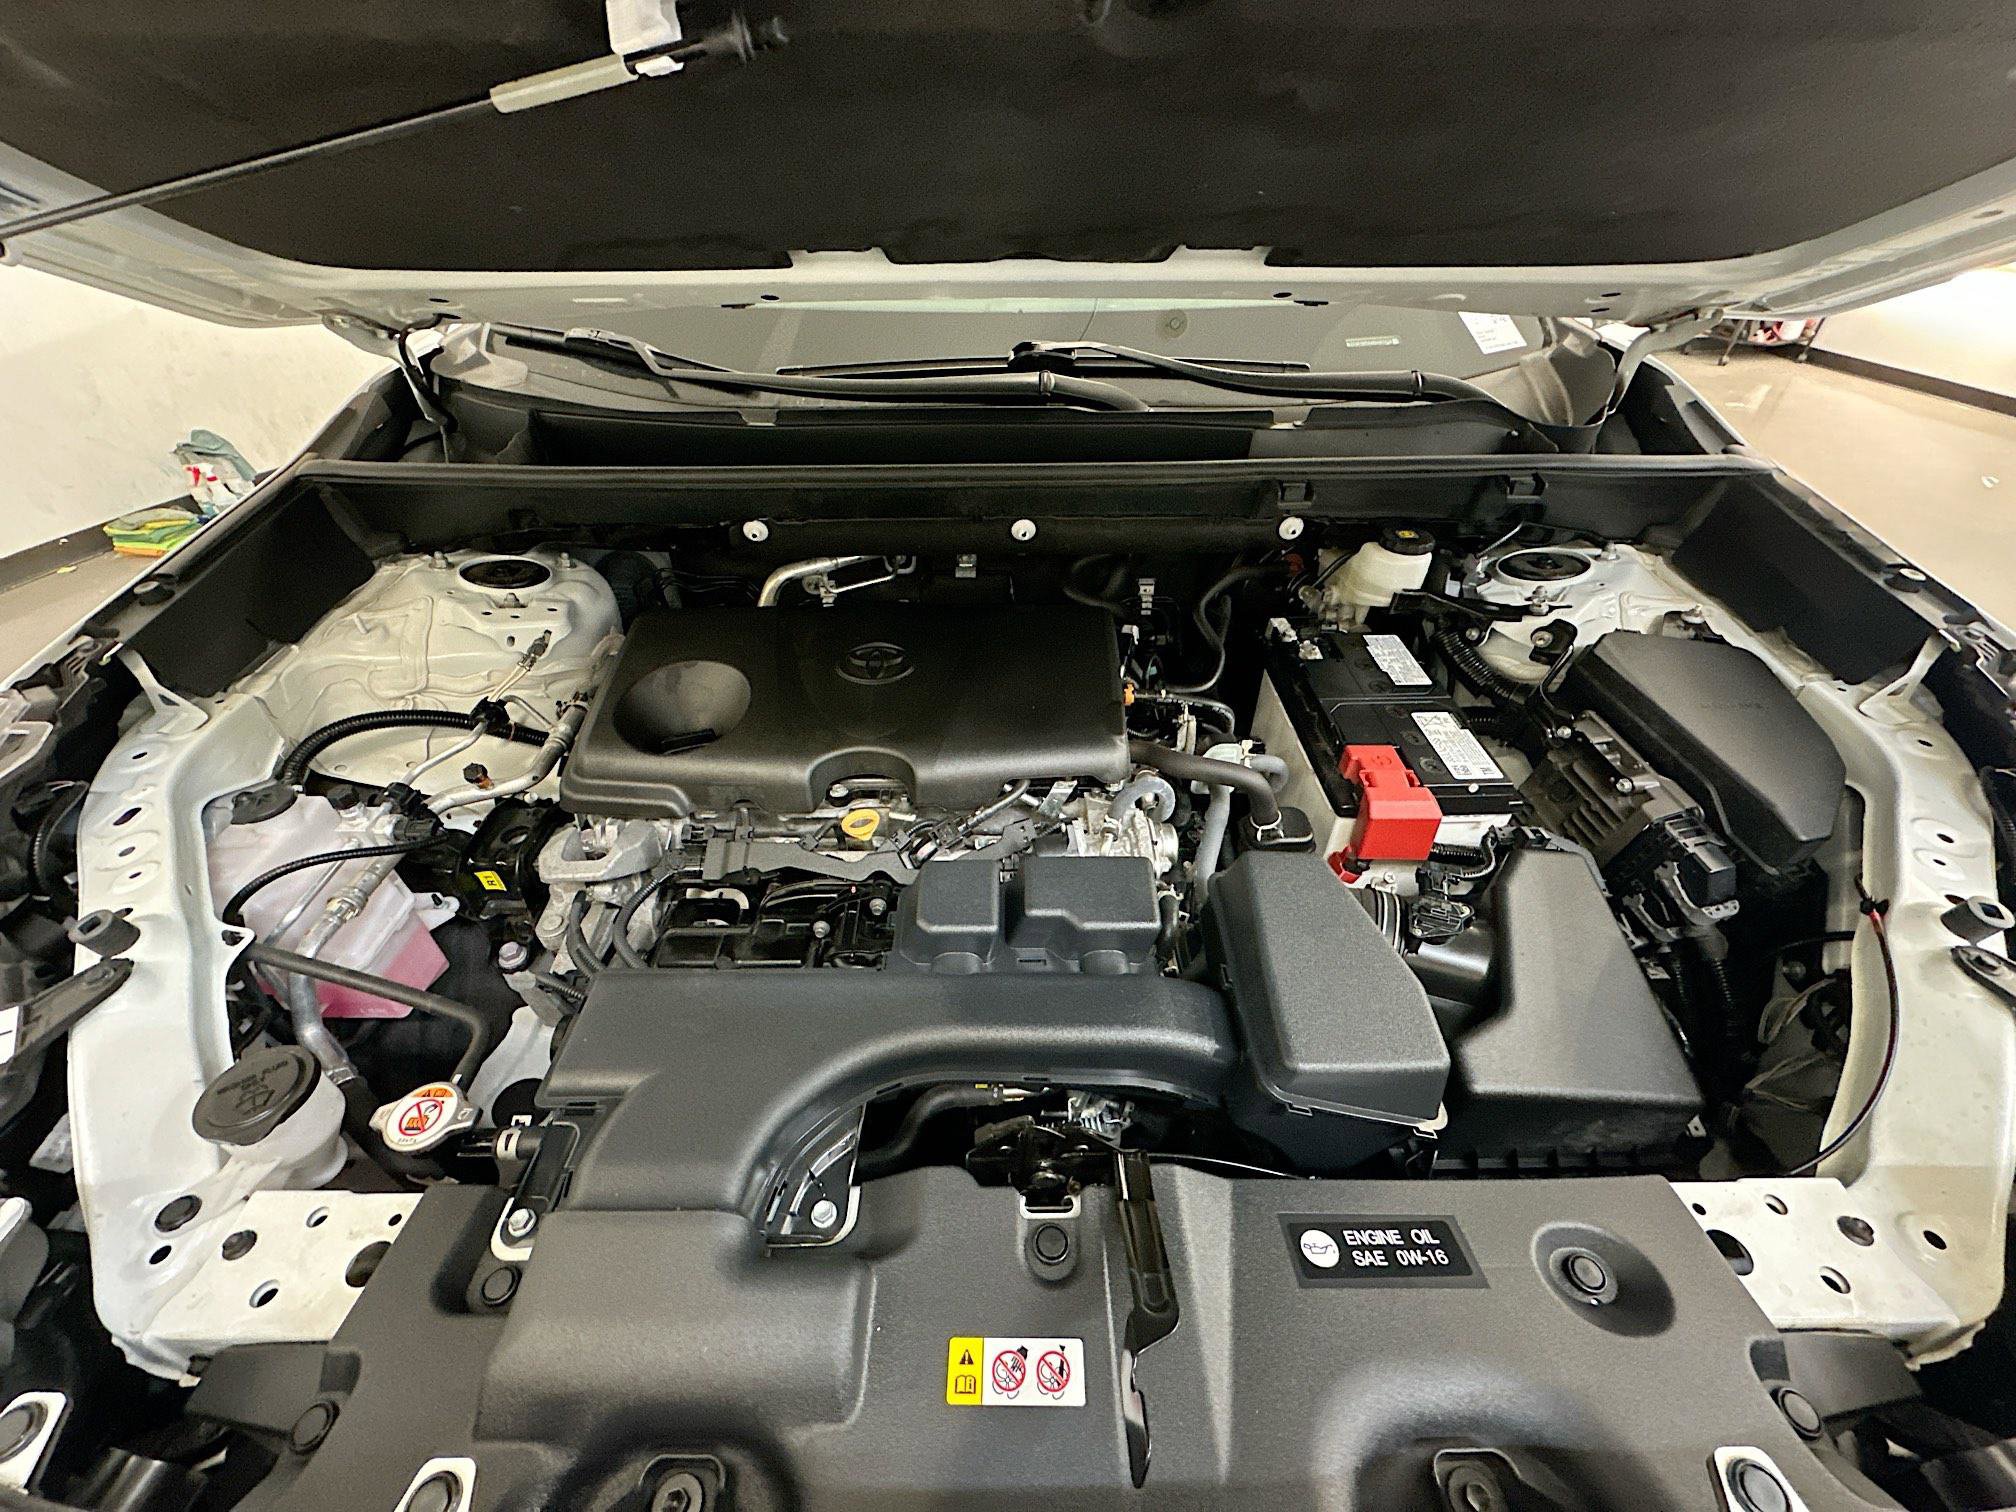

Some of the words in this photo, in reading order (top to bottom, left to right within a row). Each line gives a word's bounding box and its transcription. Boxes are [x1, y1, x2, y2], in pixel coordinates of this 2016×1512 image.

[1342, 1229, 1405, 1246] ENGINE
[1410, 1228, 1440, 1245] OIL
[1351, 1249, 1389, 1267] SAE
[1395, 1249, 1450, 1266] 0W-16
